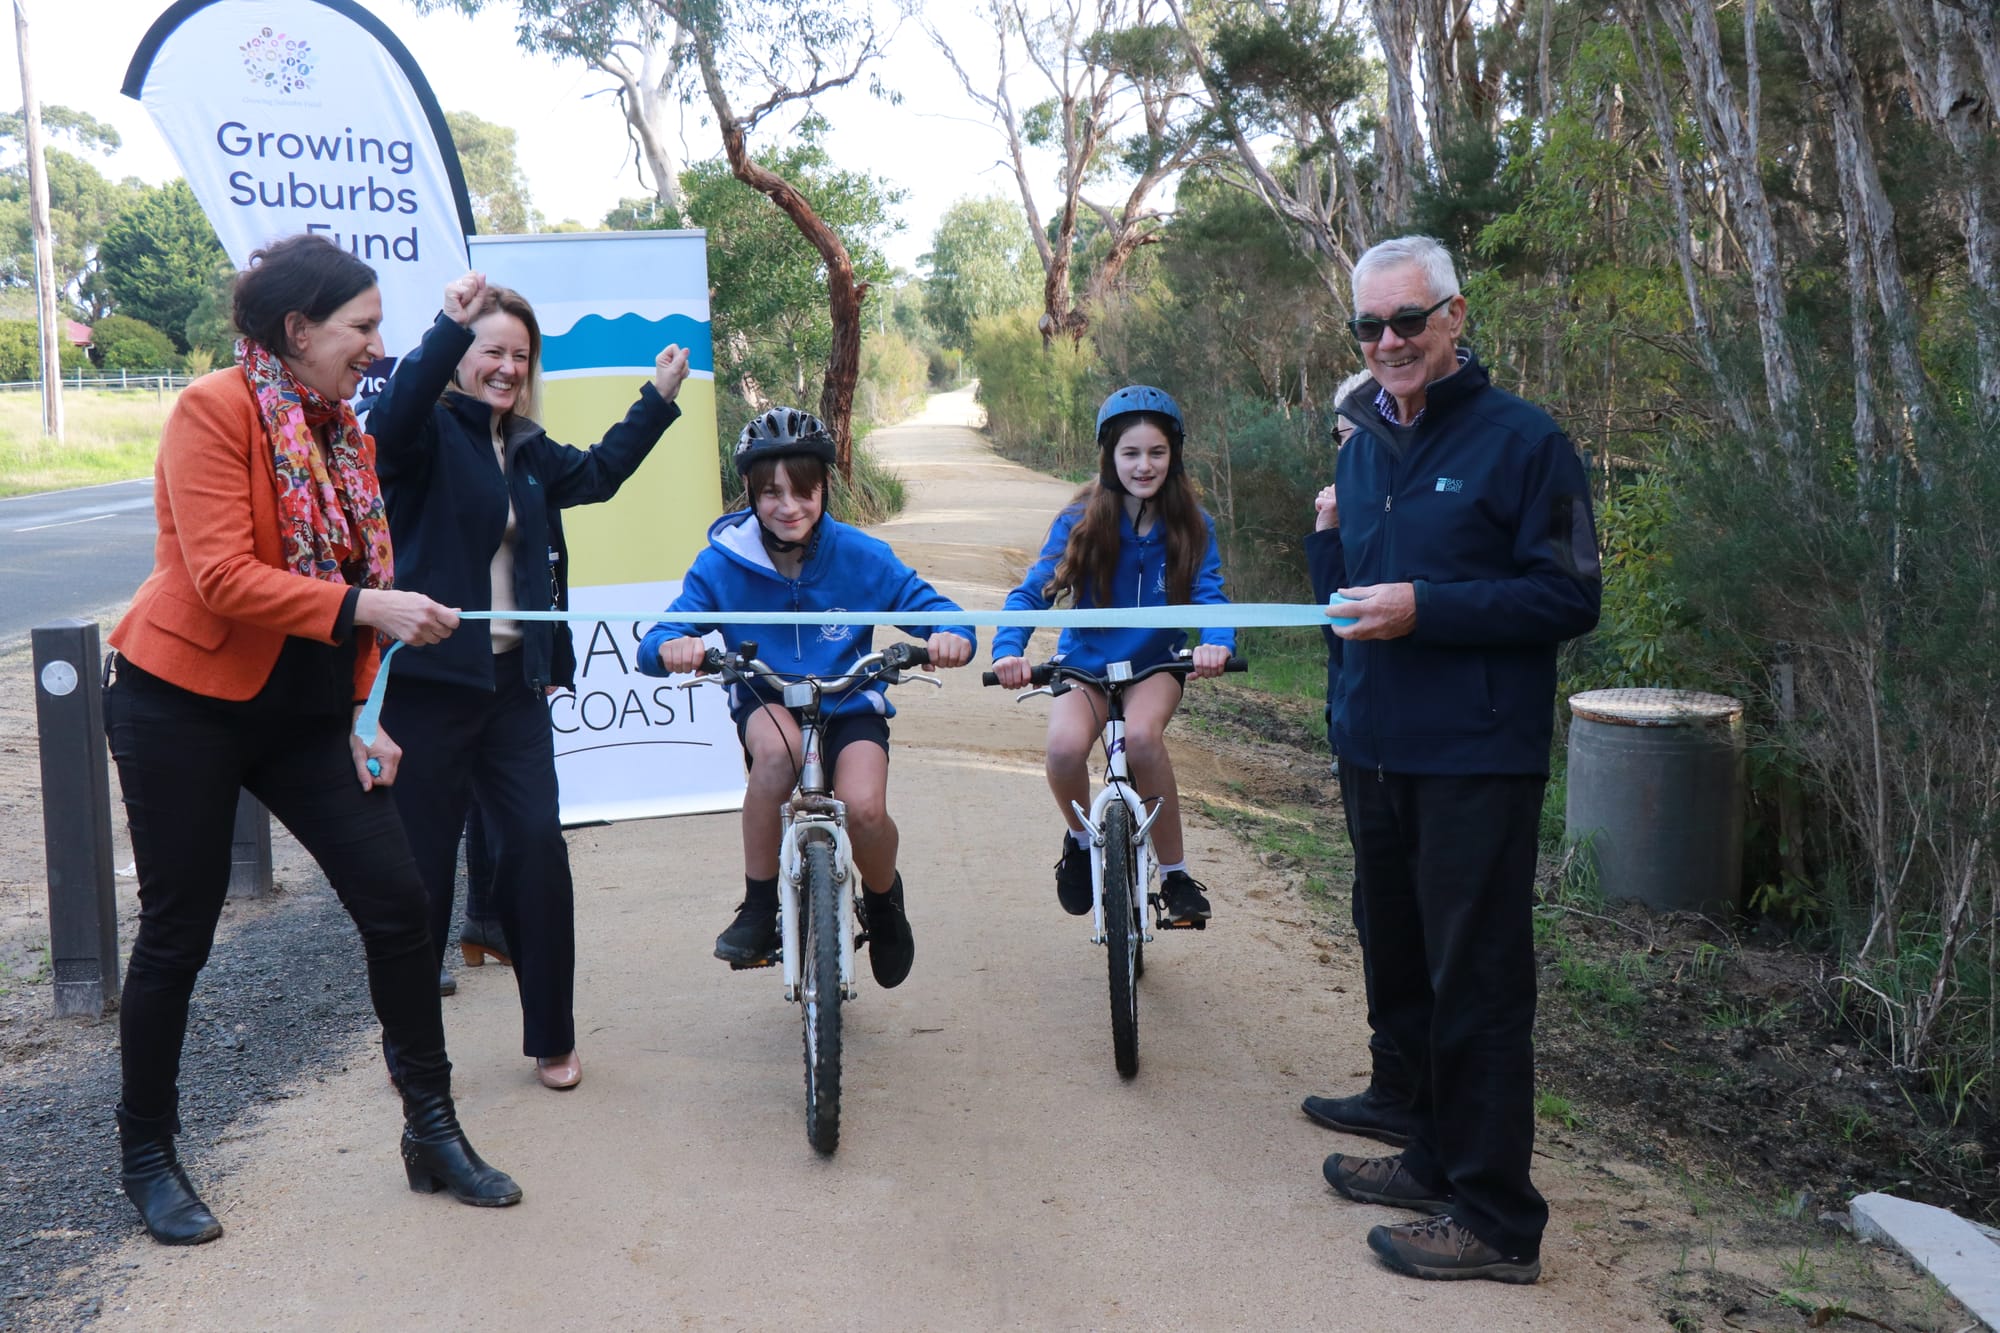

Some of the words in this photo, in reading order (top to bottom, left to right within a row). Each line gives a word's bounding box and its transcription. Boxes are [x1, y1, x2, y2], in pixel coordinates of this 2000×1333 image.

[217, 121, 413, 174] Growing
[229, 171, 418, 214] Suburbs
[550, 684, 703, 734] COAST
